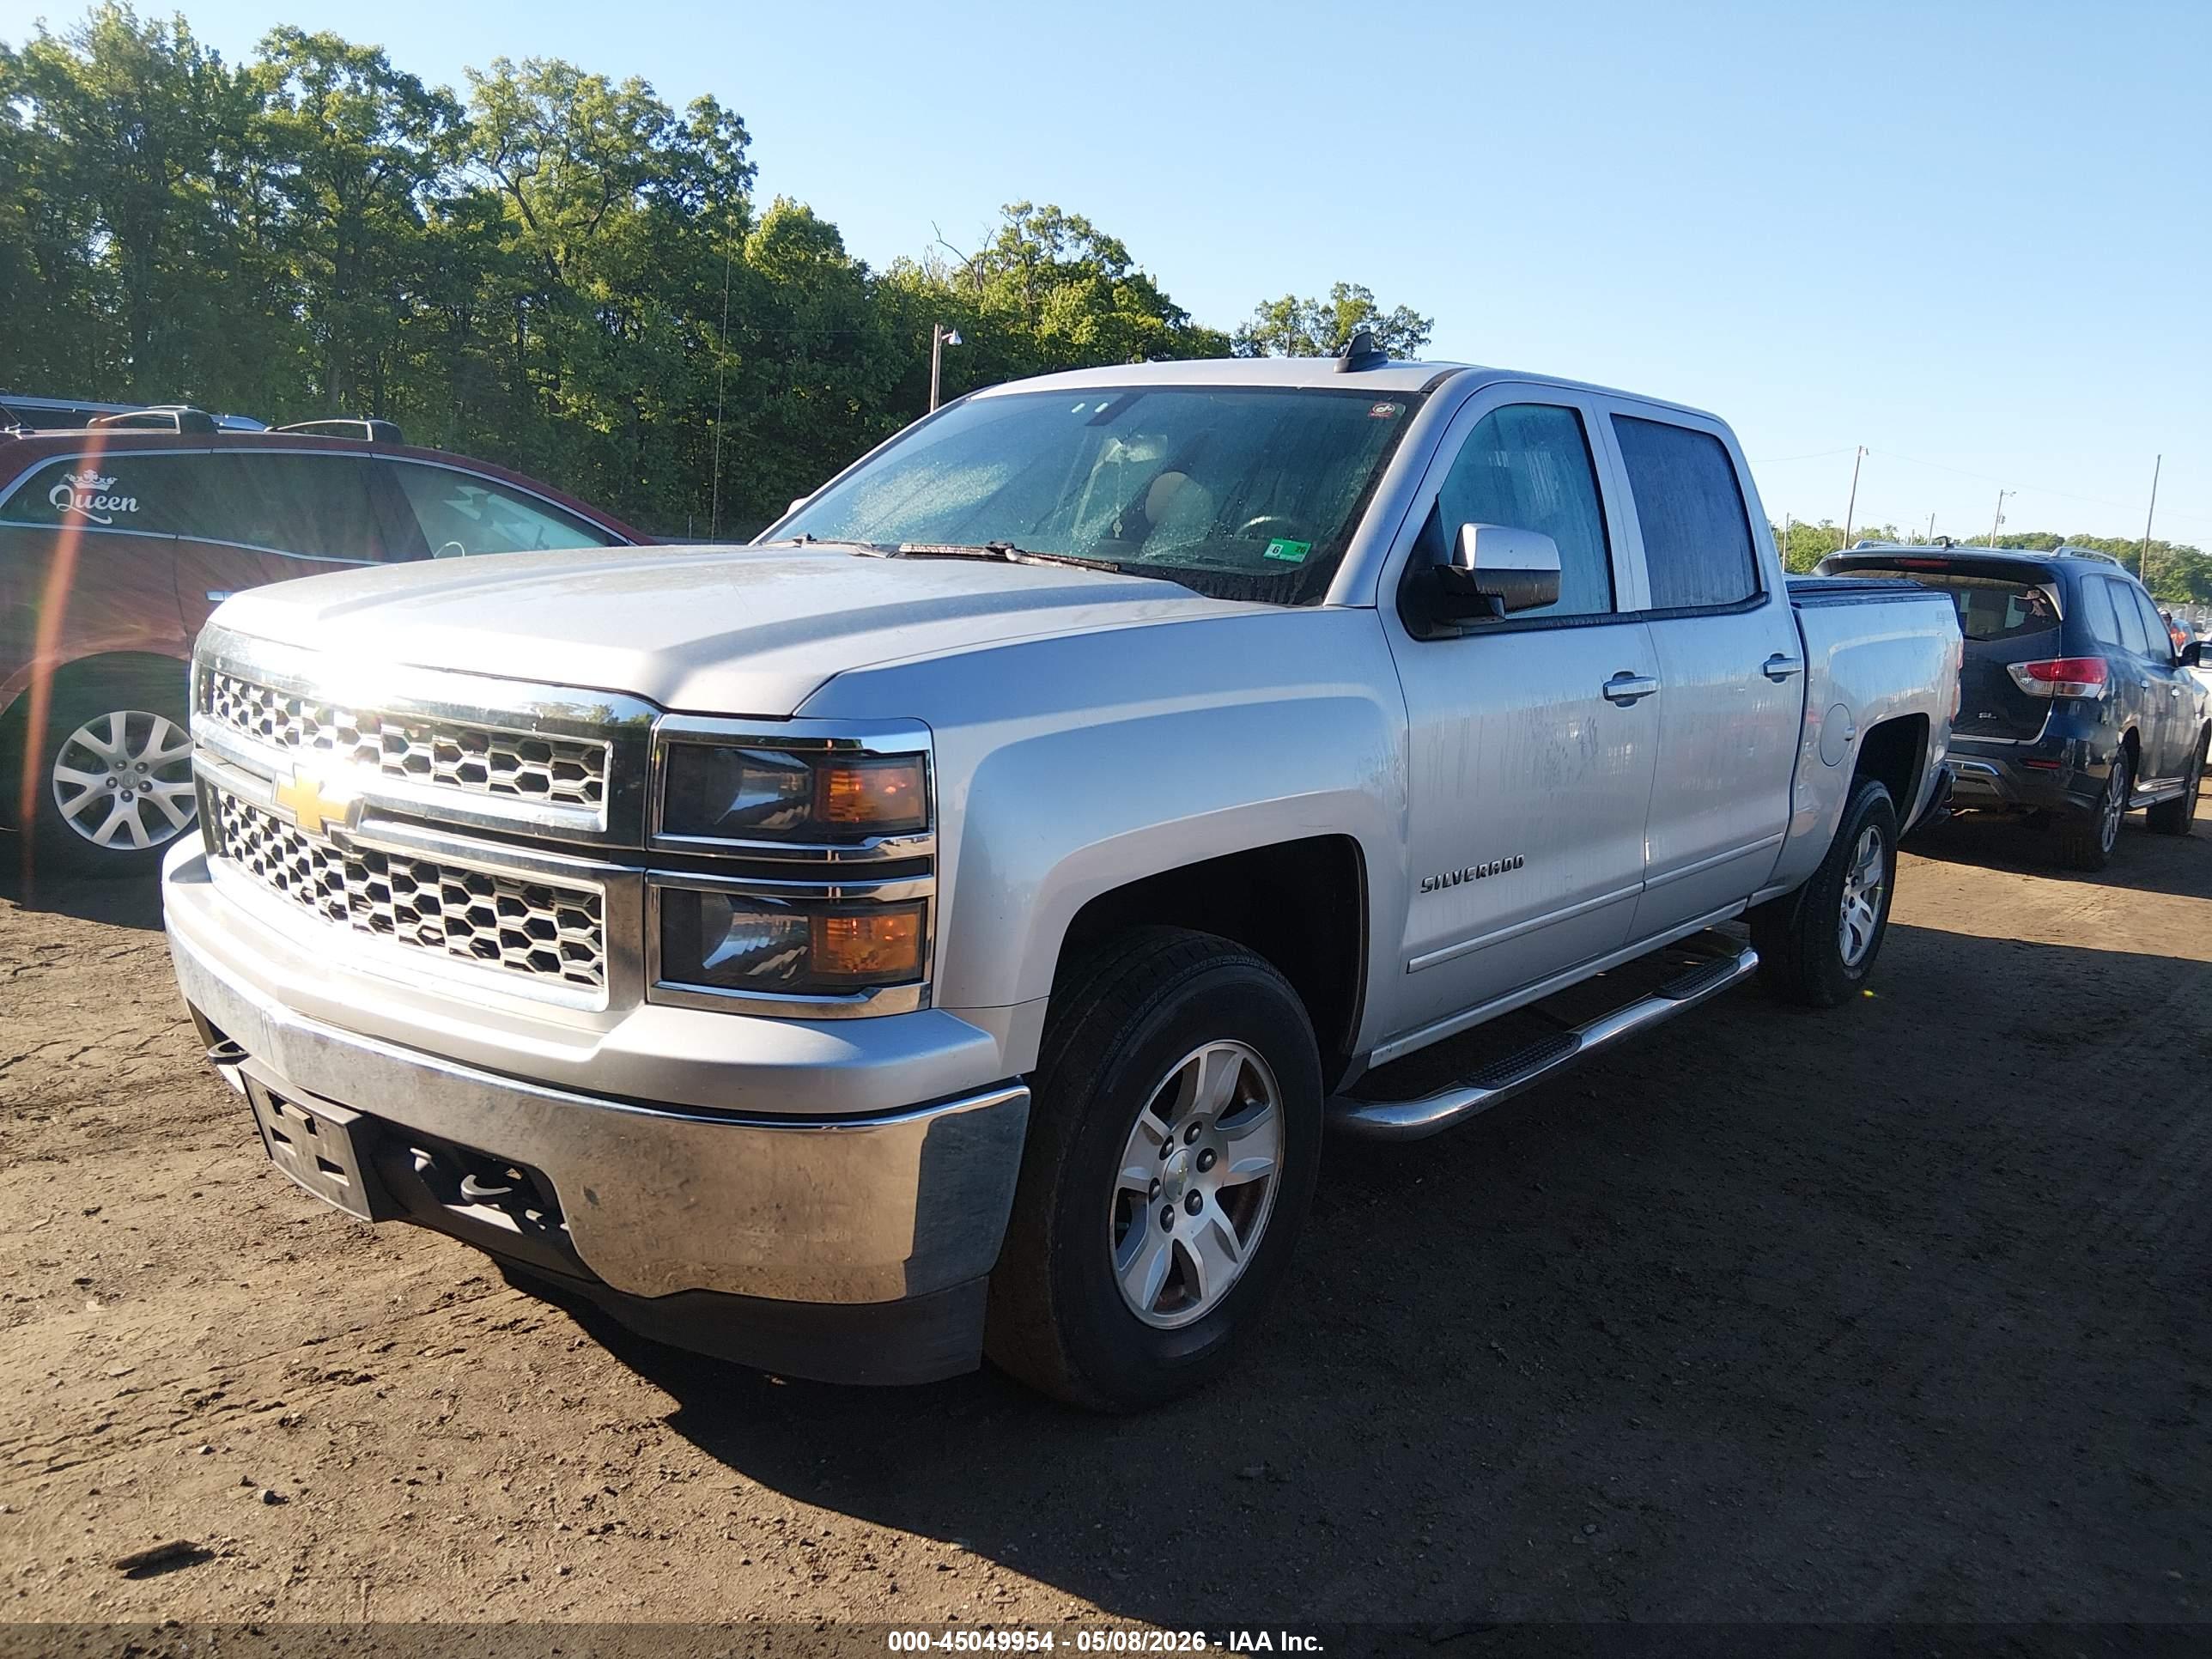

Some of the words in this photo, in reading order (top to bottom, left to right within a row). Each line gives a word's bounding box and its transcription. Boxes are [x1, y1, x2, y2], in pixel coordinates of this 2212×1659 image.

[49, 485, 139, 524] Queen
[1272, 545, 1281, 555] 6
[1420, 854, 1525, 894] SILVERADO
